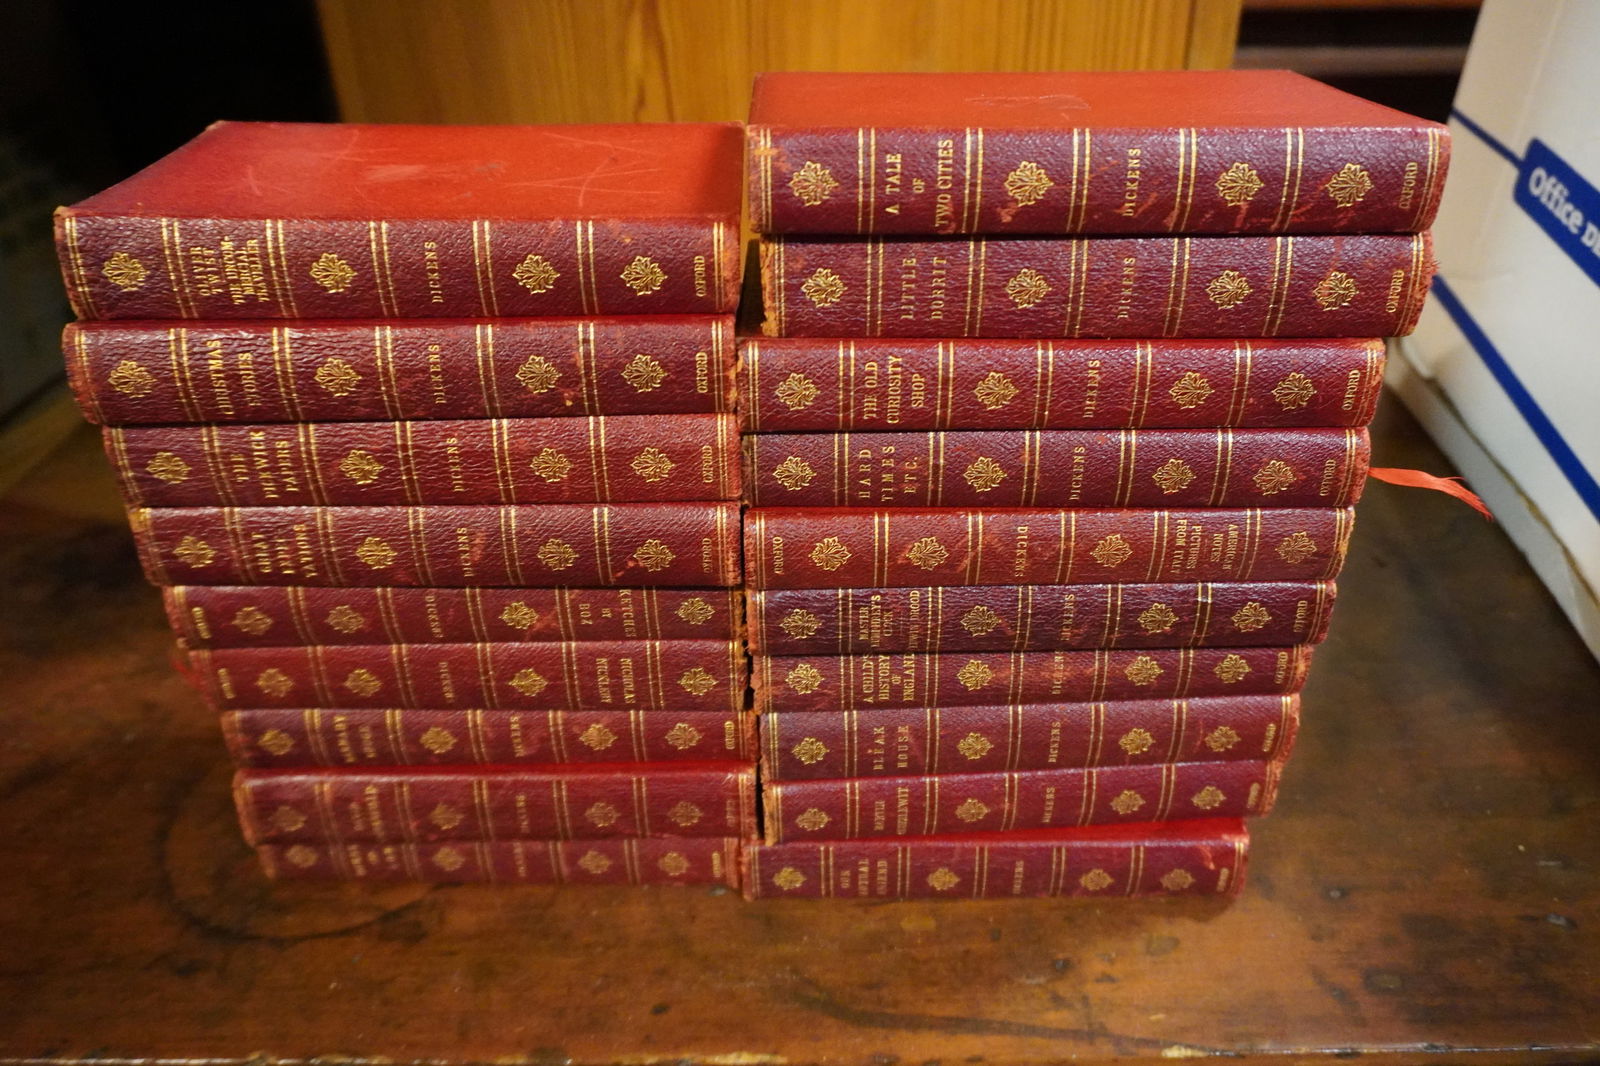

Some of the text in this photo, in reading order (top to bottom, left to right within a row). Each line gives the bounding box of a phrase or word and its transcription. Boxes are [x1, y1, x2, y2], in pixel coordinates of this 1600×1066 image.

[885, 153, 902, 215] A TALE
[912, 177, 926, 194] OF
[935, 139, 954, 228] TWO CITIES
[1121, 147, 1142, 217] DICKENS
[1400, 161, 1419, 210] OXFORD
[1528, 166, 1584, 235] Office
[189, 246, 211, 296] OLIVER
[202, 247, 223, 295] TWIST
[220, 235, 246, 305] THE UNCOM-
[246, 239, 270, 302] TRAVELLER
[424, 241, 444, 304] DICKENS
[694, 255, 707, 298] OXFORD
[900, 257, 917, 320] LITTLE
[931, 256, 947, 320] DORRIT
[1116, 256, 1136, 319] DICKENS
[1385, 269, 1405, 314] OXFORD
[206, 340, 235, 415] CHRISTMAS
[238, 352, 262, 406] STORIES
[428, 344, 447, 404] DICKENS
[695, 351, 709, 394] OXFORD
[863, 361, 879, 420] THE OLD
[887, 355, 902, 424] CURIOSITY
[911, 373, 926, 408] SHOP
[1083, 359, 1101, 418] DICKENS
[1341, 369, 1361, 411] OXFORD
[230, 454, 250, 482] THE
[249, 431, 280, 498] PICKWICK
[275, 440, 299, 492] PAPERS
[446, 437, 465, 492] DICKENS
[701, 445, 714, 484] OXFORD
[858, 449, 872, 499] HARD
[881, 445, 896, 502] TIMES
[904, 456, 919, 494] ETC.
[1069, 445, 1086, 501] DICKENS
[1319, 458, 1337, 497] OXFORD
[456, 527, 475, 577] DICKENS
[702, 537, 713, 574] OXFORD
[772, 536, 784, 575] OXFORD
[1014, 525, 1029, 578] DICKENS
[1170, 519, 1188, 574] FROM ITALY
[1186, 525, 1202, 569] PICTURES
[1210, 533, 1224, 562] NOTES
[1222, 523, 1239, 570] AMERICAN
[601, 607, 613, 618] BY
[619, 588, 637, 638] KETCHES
[858, 606, 869, 641] MASTER
[909, 590, 920, 621] DROOD
[1060, 593, 1076, 641] DICKENS
[1293, 600, 1308, 633] OXFORD
[620, 657, 636, 704] NICHOLAS
[863, 696, 874, 704] A
[878, 654, 890, 701] HISTORY
[891, 673, 902, 685] OF
[872, 726, 886, 770] BLEAK
[897, 724, 910, 768] HOUSE
[1048, 721, 1062, 763] DICKENS
